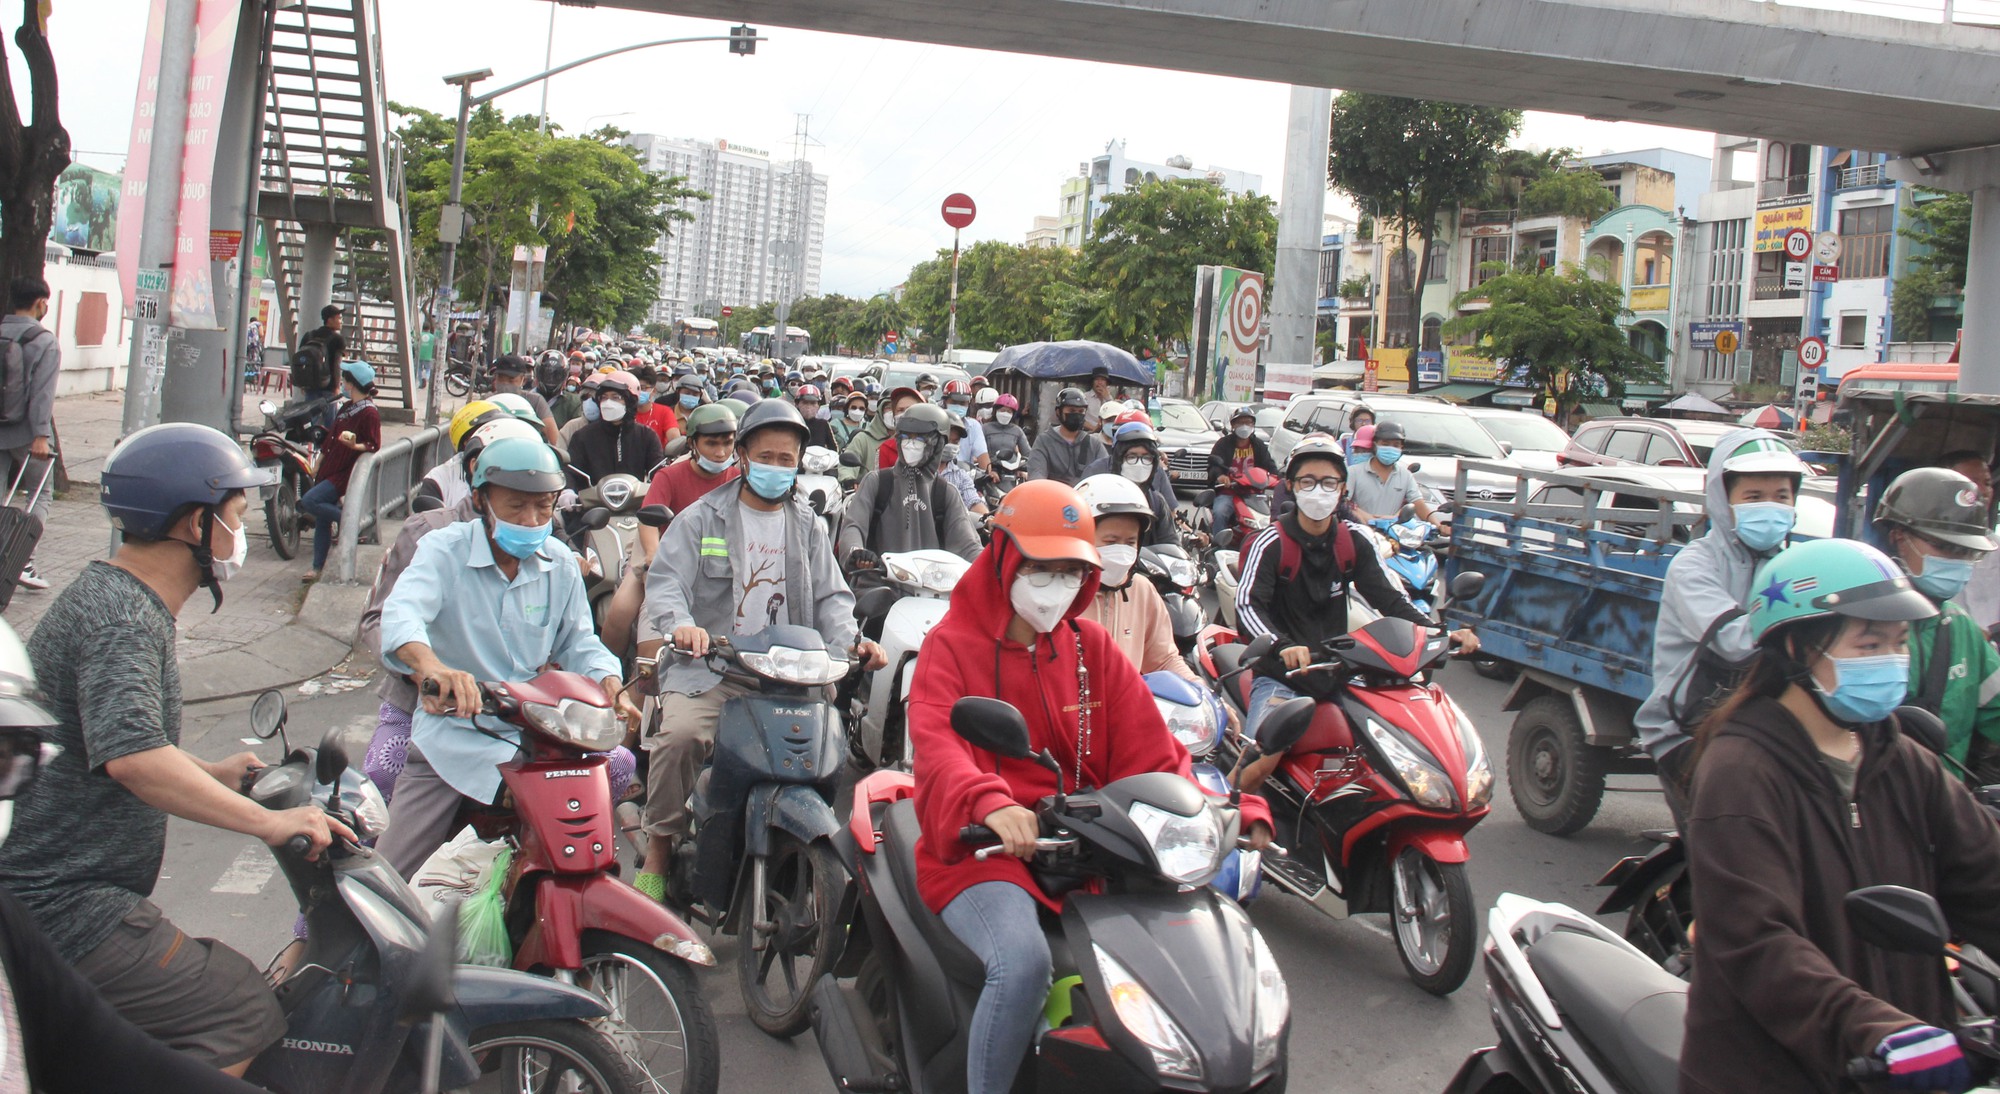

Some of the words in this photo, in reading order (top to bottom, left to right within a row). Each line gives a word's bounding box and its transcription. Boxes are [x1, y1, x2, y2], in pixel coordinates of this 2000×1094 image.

[1792, 237, 1804, 251] 70
[1805, 346, 1818, 360] 60
[545, 769, 590, 779] PENMAN
[281, 1037, 355, 1056] HONDA
